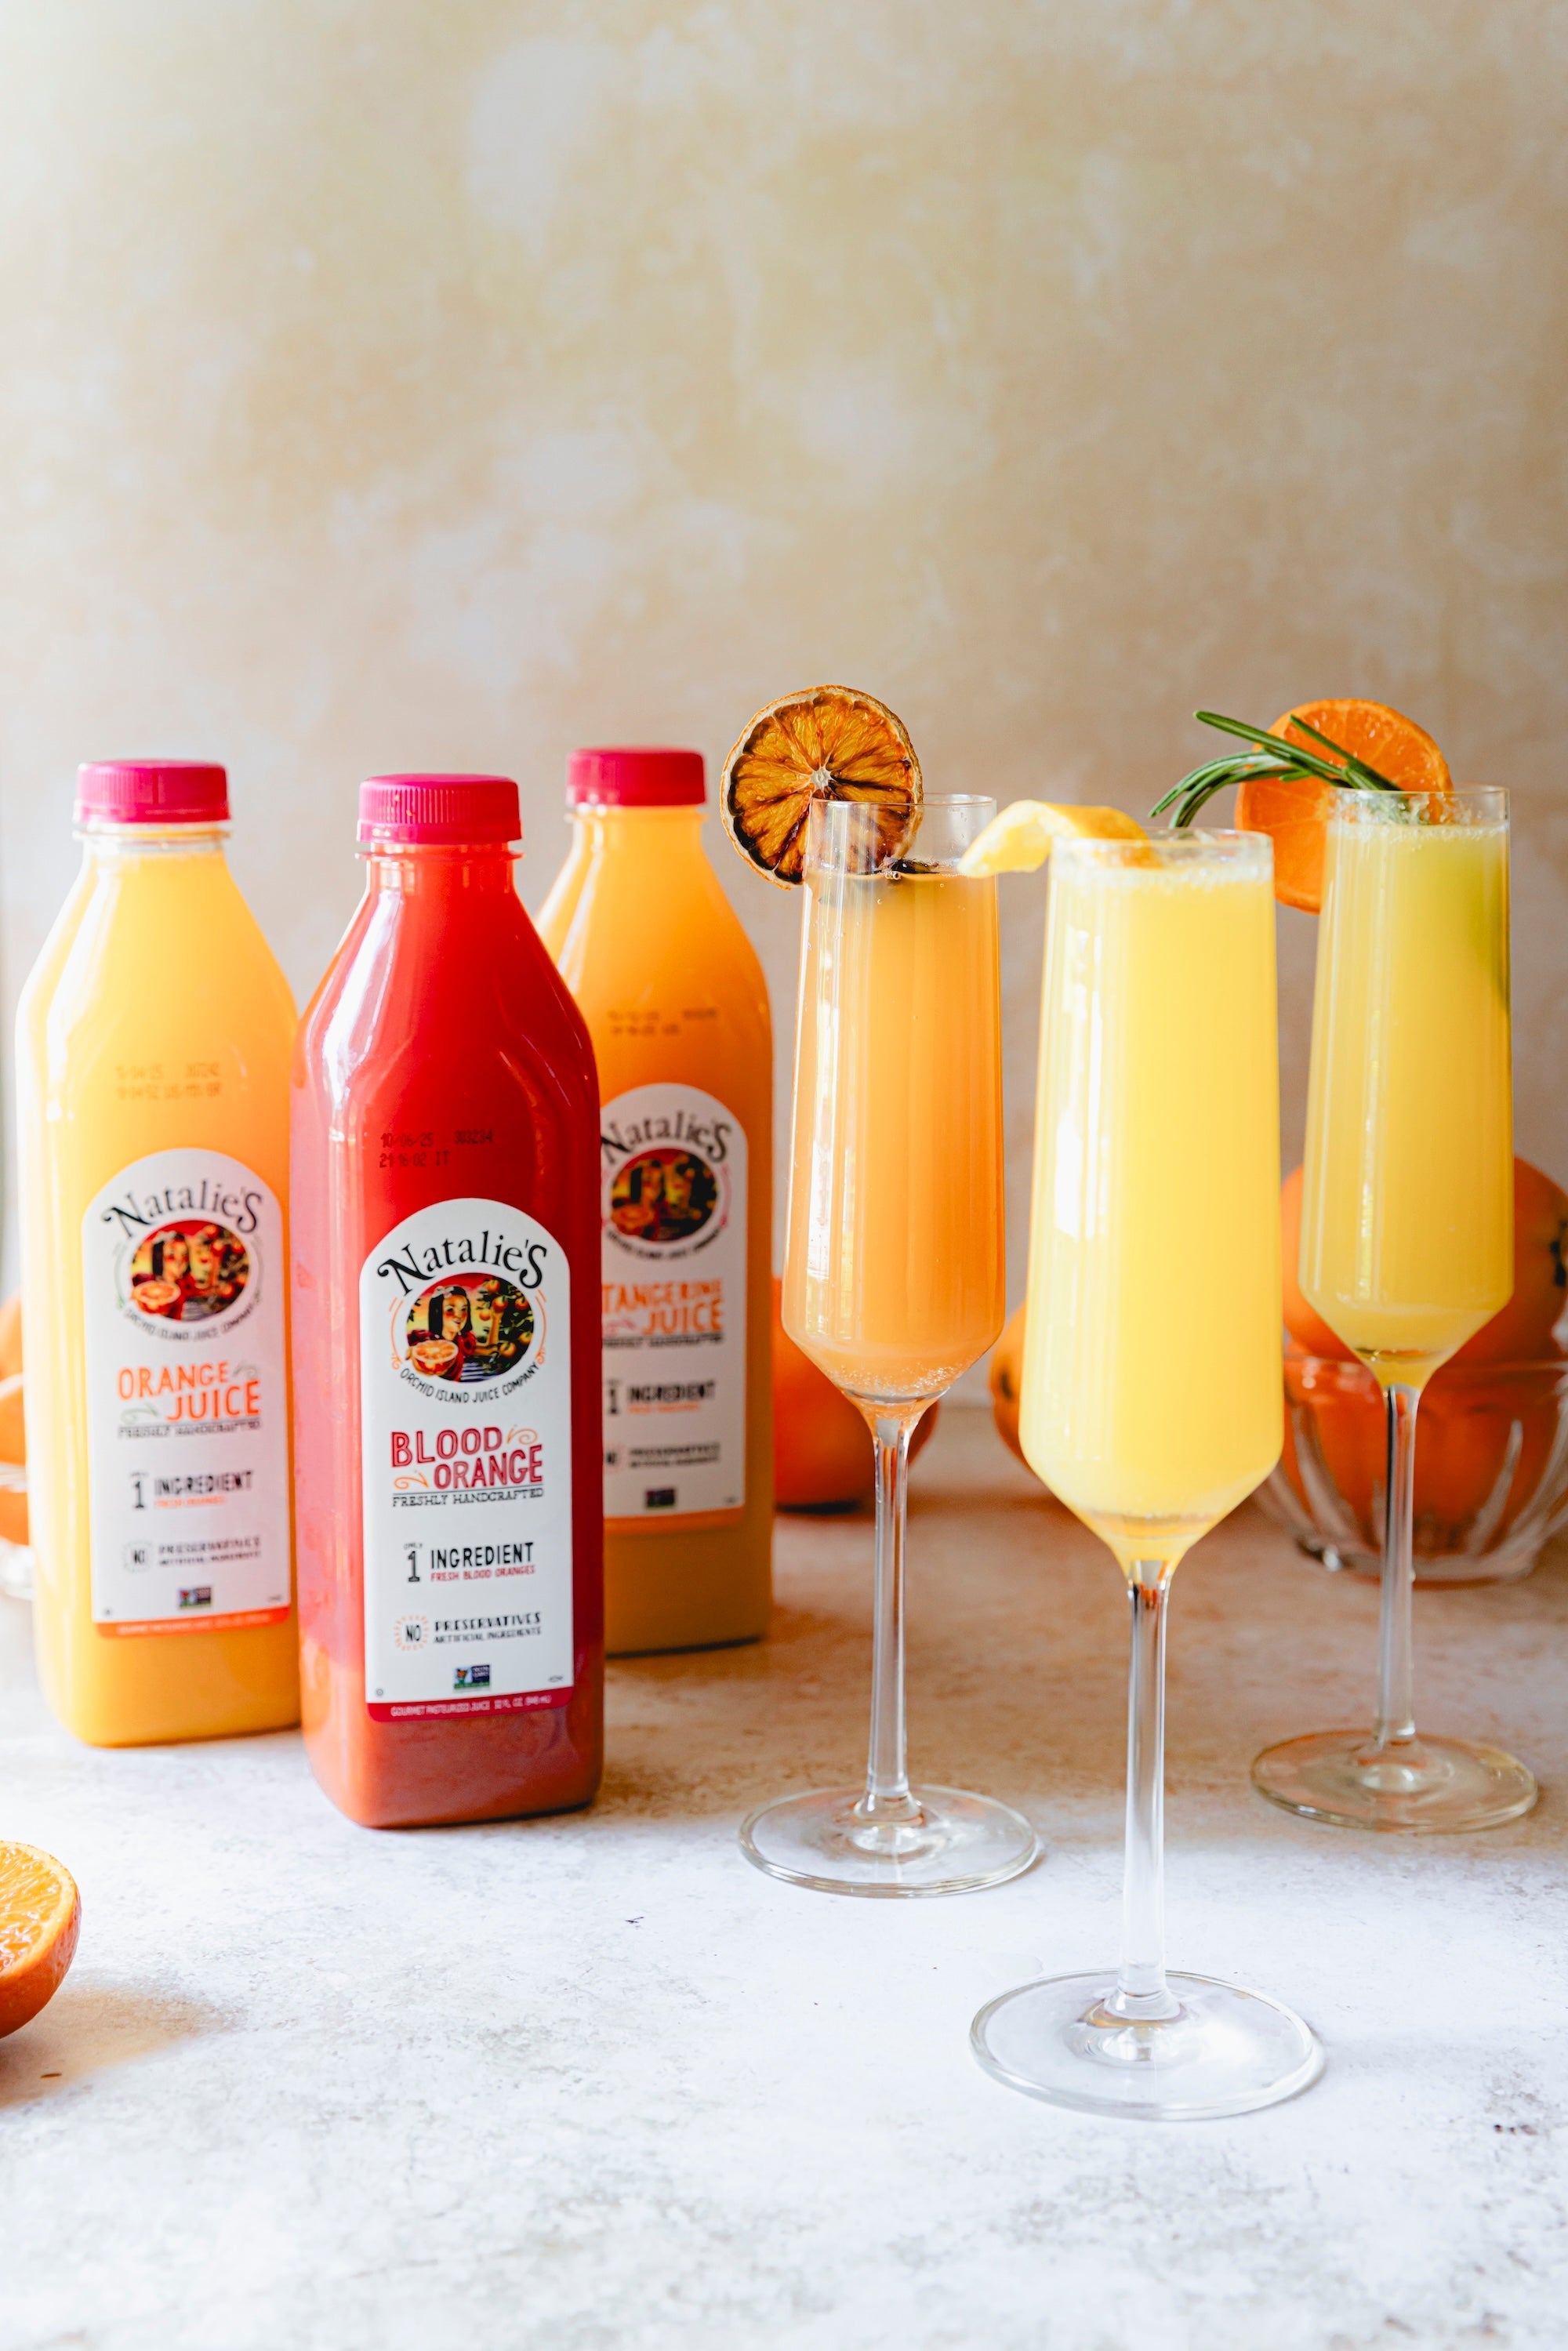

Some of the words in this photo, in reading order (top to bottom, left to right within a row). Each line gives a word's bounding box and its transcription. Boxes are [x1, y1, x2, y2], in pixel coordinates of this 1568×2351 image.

[602, 1277, 722, 1315] TANGERINE
[641, 1298, 723, 1336] JUICE
[118, 1361, 230, 1400] ORANGE
[400, 1368, 434, 1397] ORCHID
[435, 1388, 470, 1403] ISLAND
[472, 1387, 499, 1403] JUICE
[502, 1362, 539, 1396] COMPANY
[166, 1380, 260, 1421] JUICE
[390, 1426, 503, 1468] BLOOD
[434, 1444, 543, 1490] ORANGE
[134, 1481, 145, 1508] 1
[154, 1470, 252, 1495] INGREDIENT
[392, 1494, 448, 1507] FRESHLY
[453, 1487, 544, 1504] HANDCRAFTED
[408, 1551, 420, 1583] 1
[430, 1542, 534, 1569] INGREDIENT
[430, 1571, 459, 1582] FRESH
[463, 1569, 492, 1580] BLOOD
[495, 1565, 535, 1577] ORANGES
[405, 1624, 422, 1642] NO
[435, 1612, 541, 1632] PRESERVATIVES
[470, 1700, 491, 1712] JUICE
